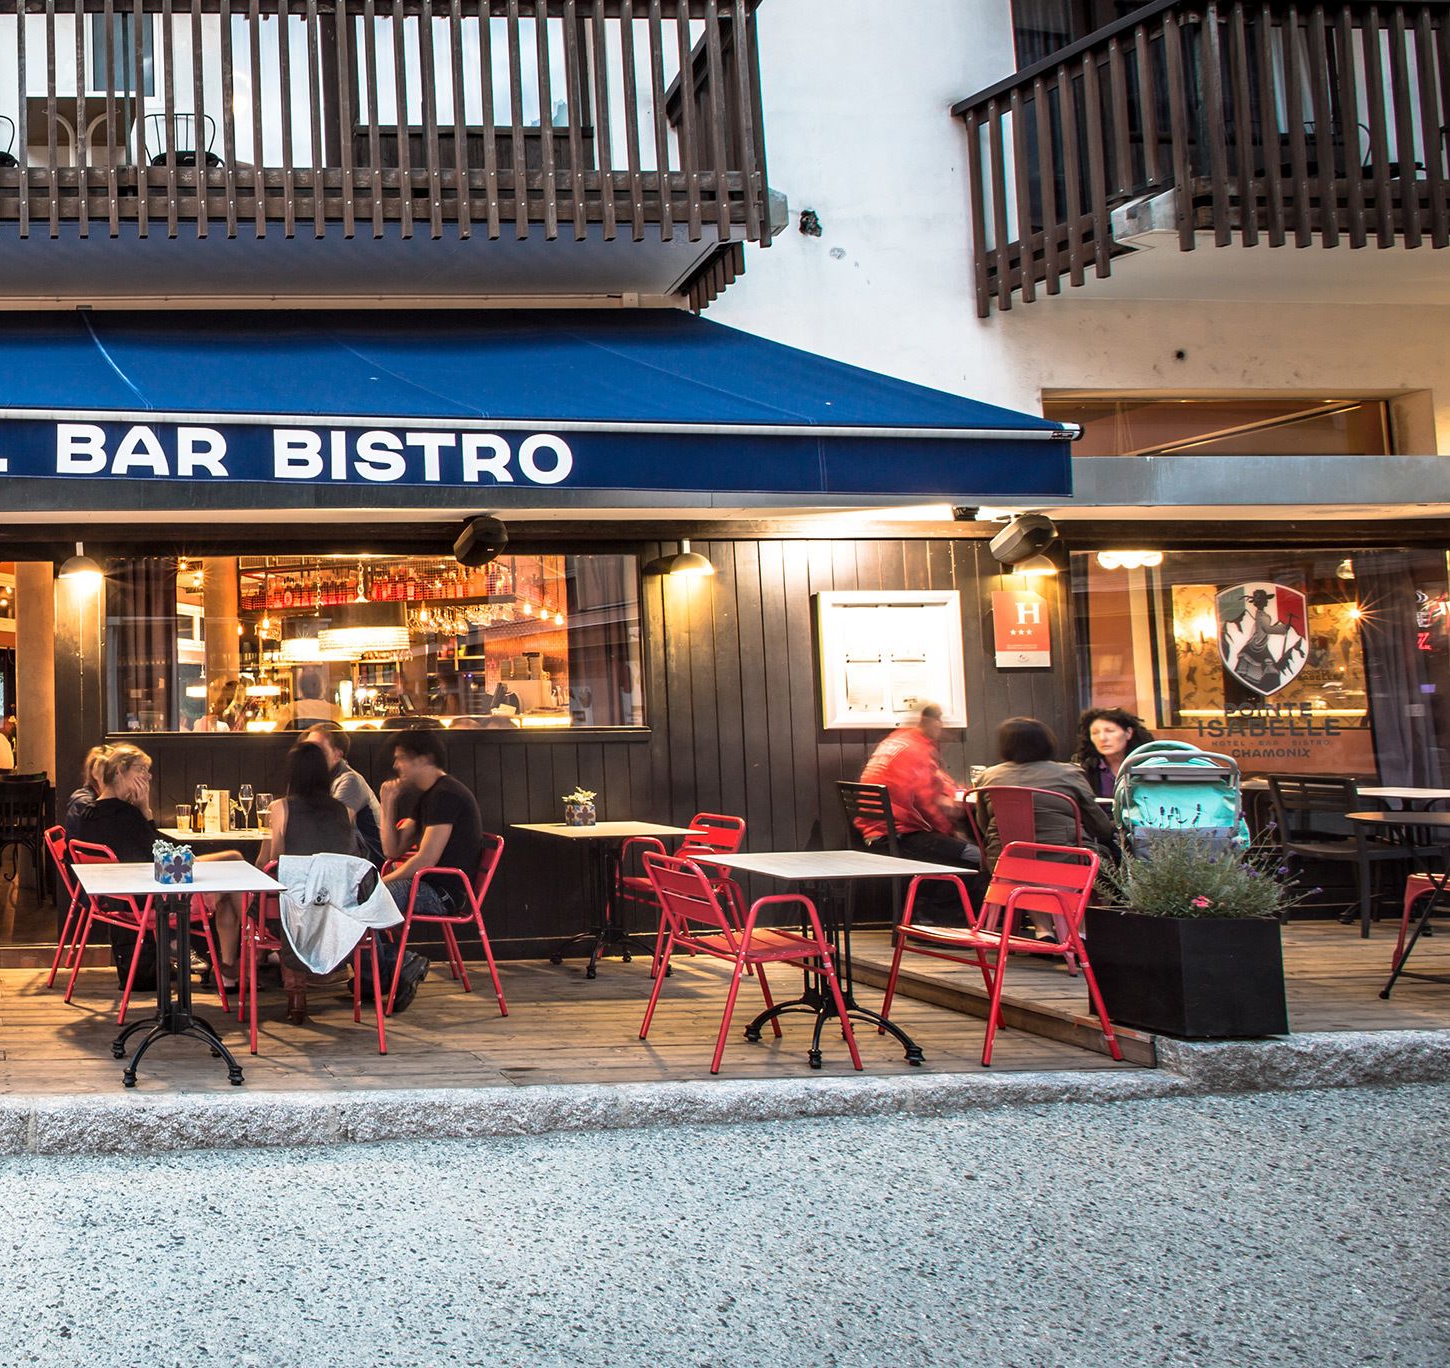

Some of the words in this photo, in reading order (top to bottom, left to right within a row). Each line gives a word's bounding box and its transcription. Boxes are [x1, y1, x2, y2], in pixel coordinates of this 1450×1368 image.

[56, 423, 229, 477] BAR
[273, 429, 573, 484] BISTRO
[1014, 602, 1042, 625] H
[1224, 702, 1312, 718] POINTE
[1197, 718, 1342, 738] ISABELLE
[1292, 739, 1330, 747] BISTRO
[1231, 748, 1310, 758] CHAMONIX
